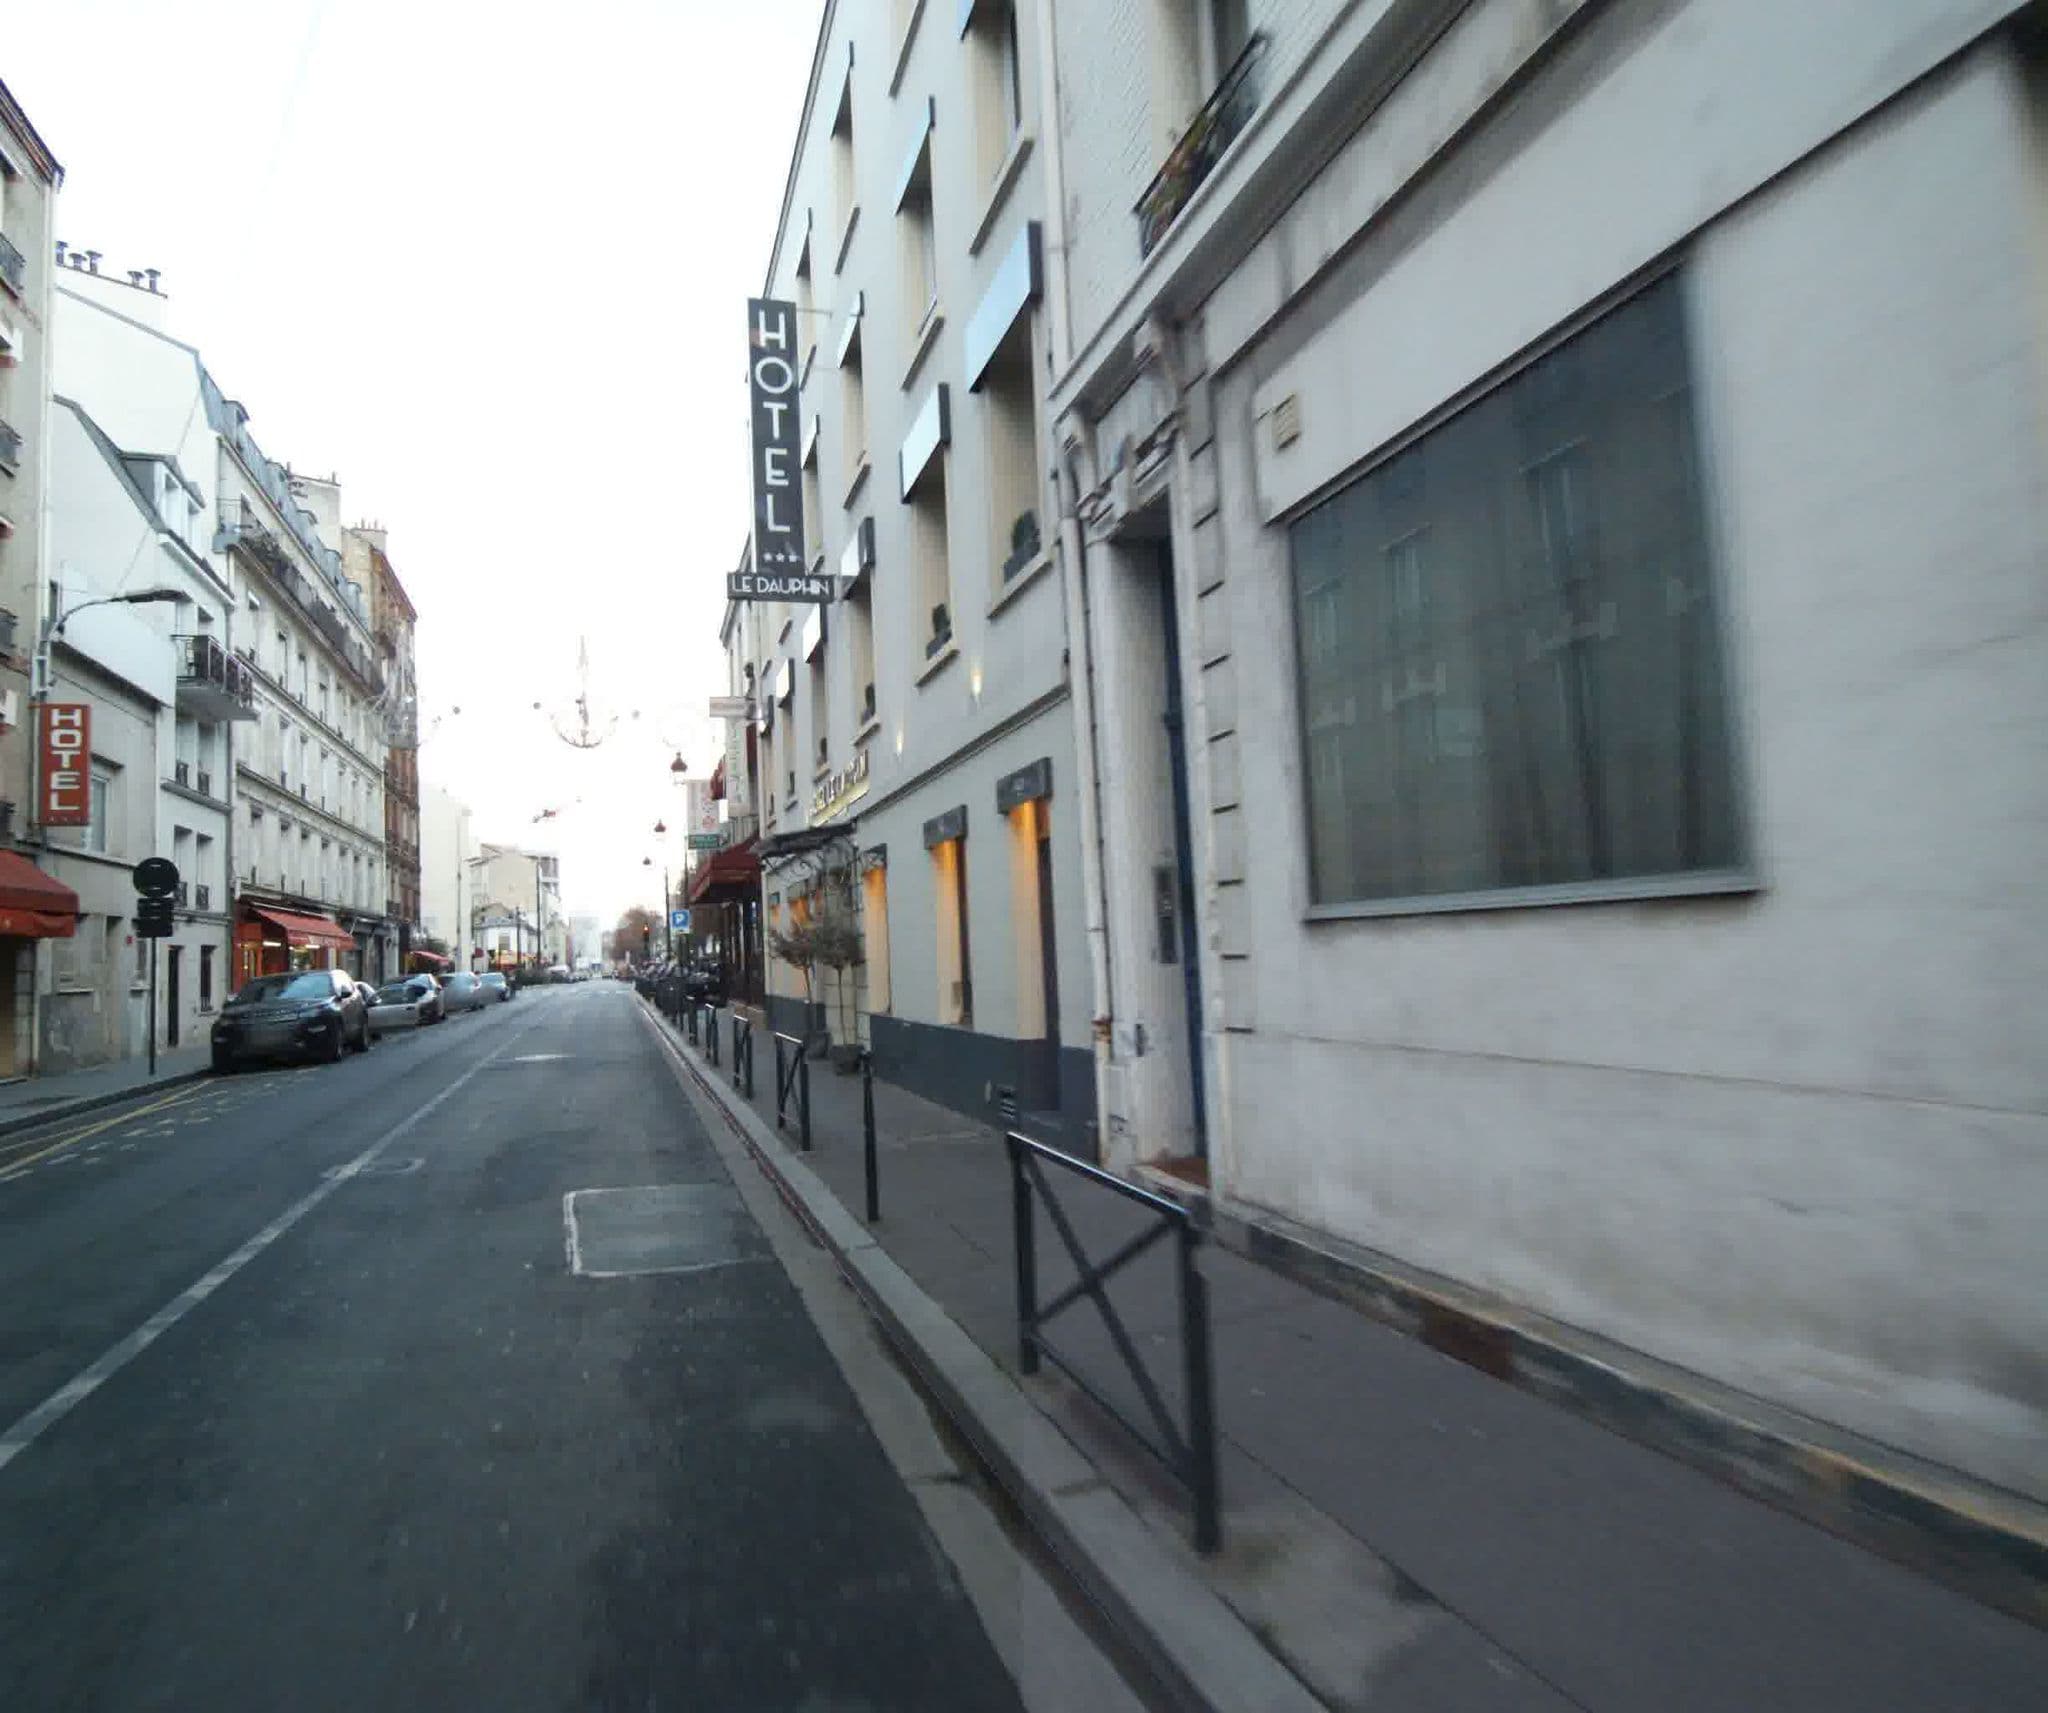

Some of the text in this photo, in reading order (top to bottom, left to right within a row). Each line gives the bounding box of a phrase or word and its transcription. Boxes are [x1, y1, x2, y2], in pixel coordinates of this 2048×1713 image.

[755, 309, 793, 533] HOTEL
[732, 575, 829, 596] LE DAUPHIN
[50, 708, 82, 811] HOTEL
[675, 913, 685, 925] P
